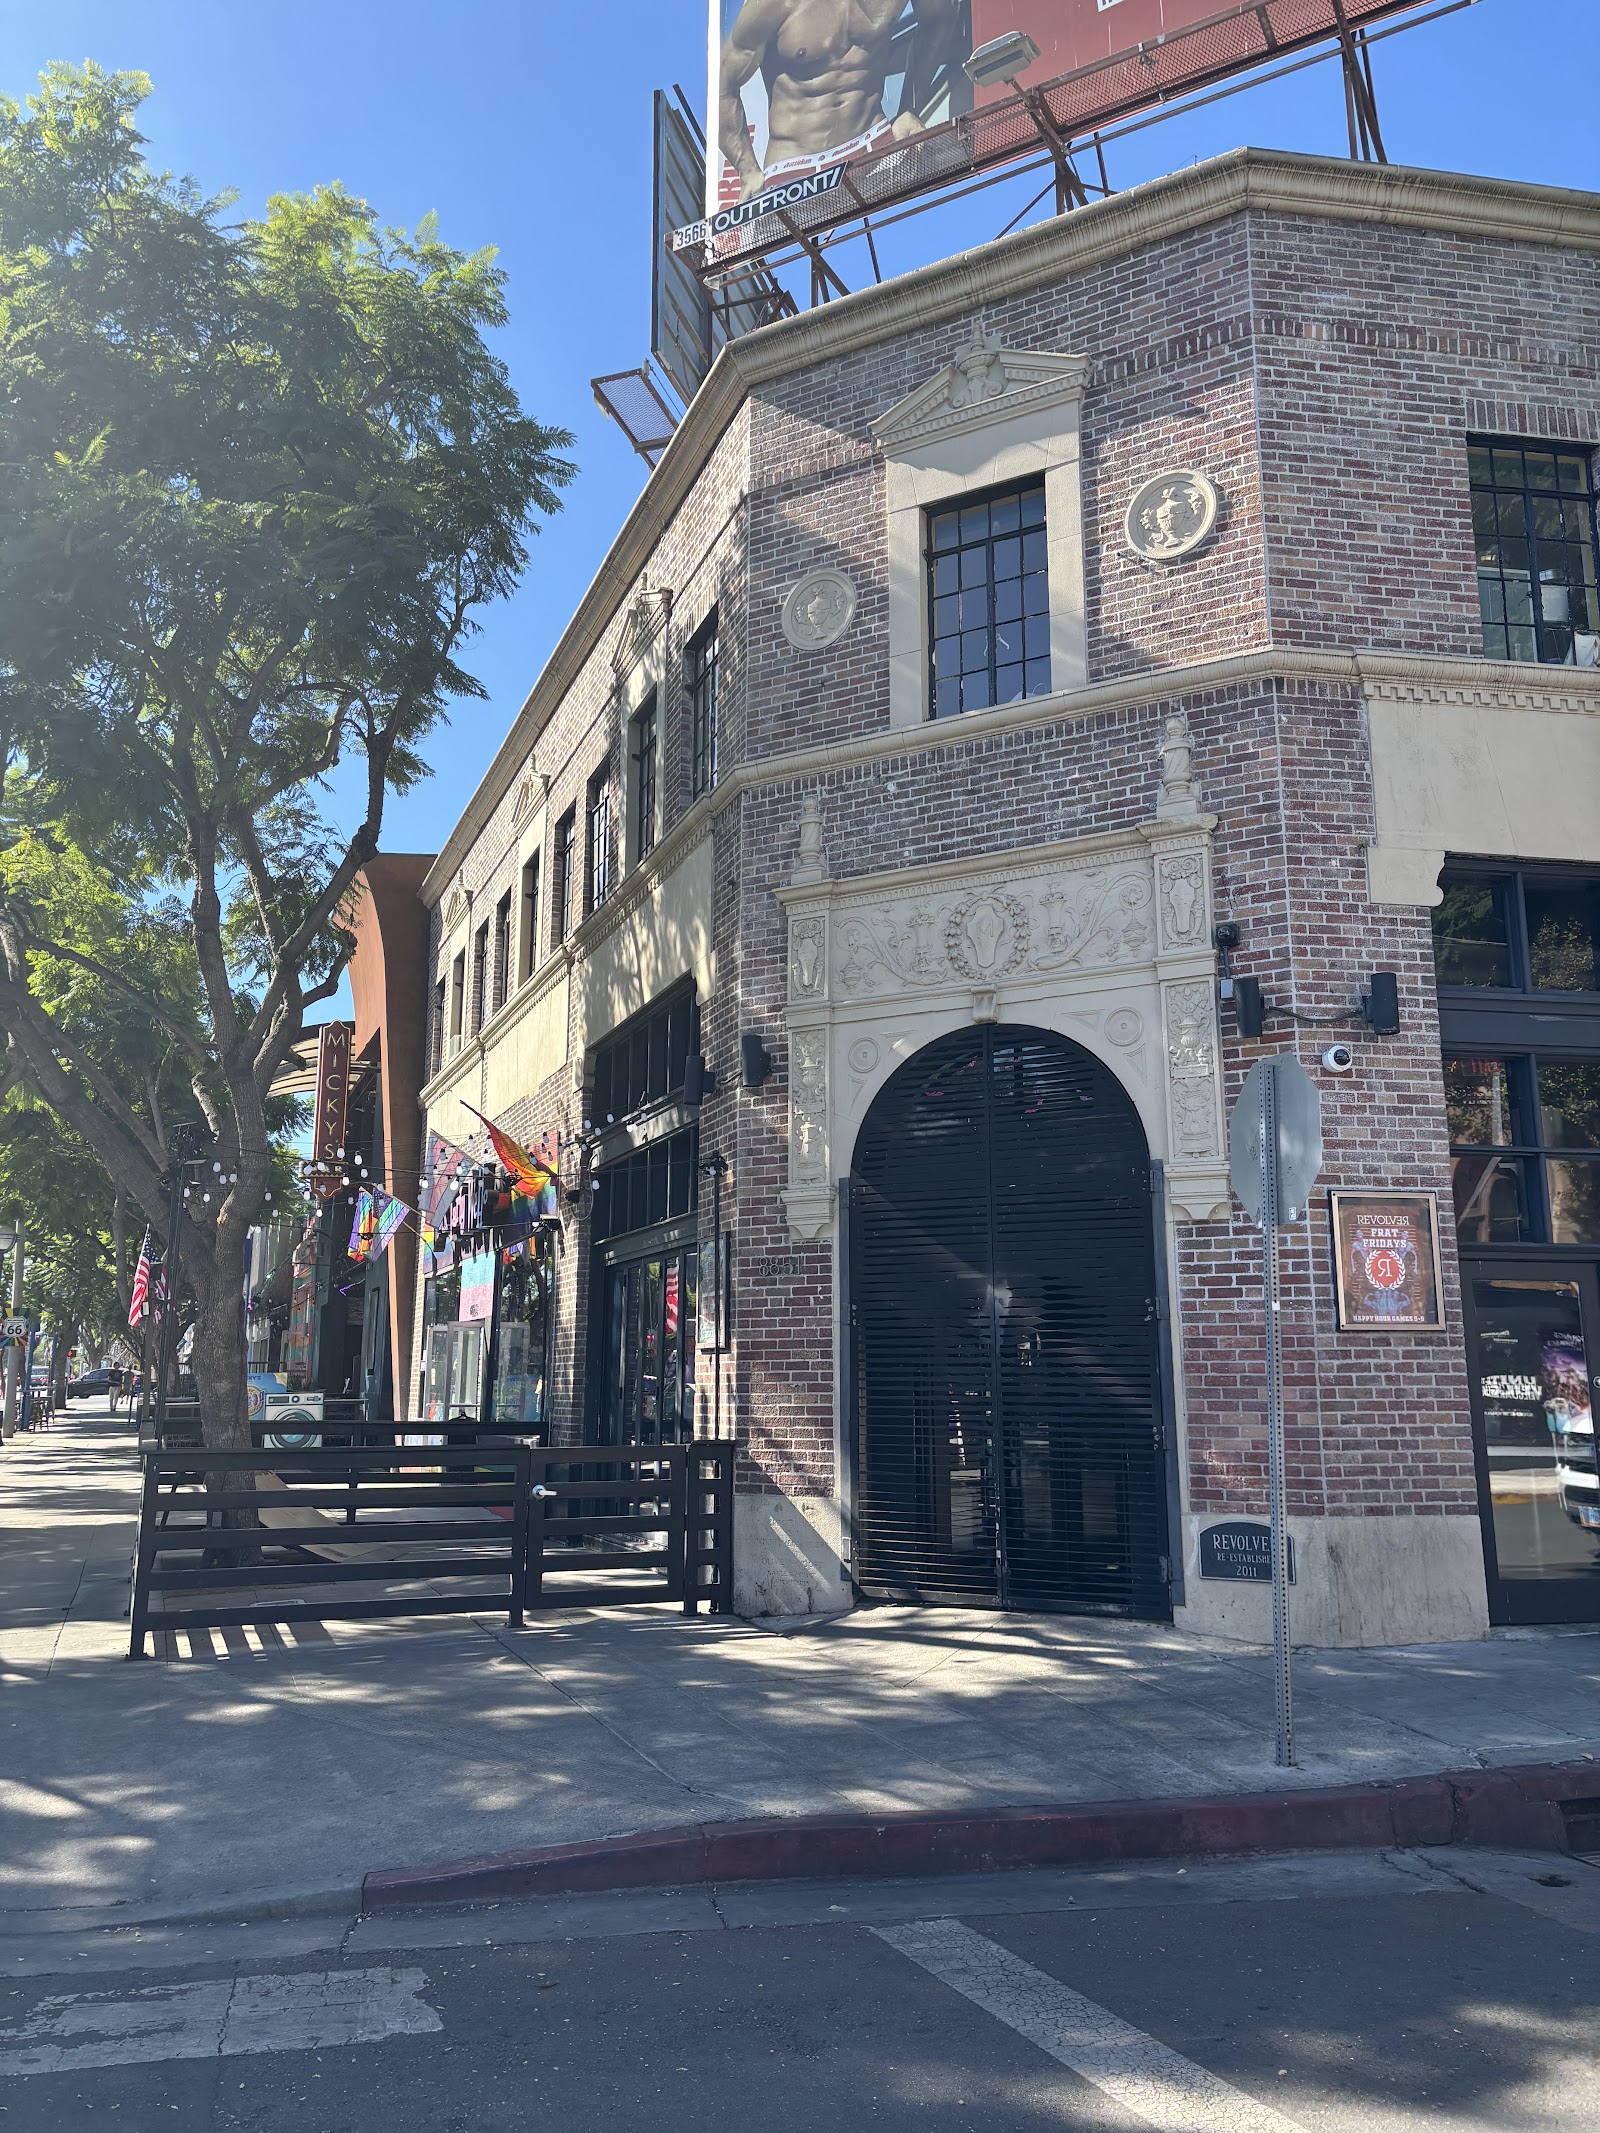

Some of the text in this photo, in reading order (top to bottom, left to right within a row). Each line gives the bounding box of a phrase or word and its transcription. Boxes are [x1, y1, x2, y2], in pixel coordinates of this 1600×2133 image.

[676, 222, 708, 248] 3566
[324, 1032, 346, 1160] MICKY'S
[1371, 1228, 1399, 1237] FRAT
[1362, 1239, 1407, 1248] FRIDAYS
[759, 1256, 800, 1276] 8851
[7, 1325, 22, 1335] 66
[1212, 1533, 1271, 1552] REVOLVE
[1216, 1552, 1271, 1564] RE-ESTABLISHE
[1236, 1565, 1257, 1577] 2011
